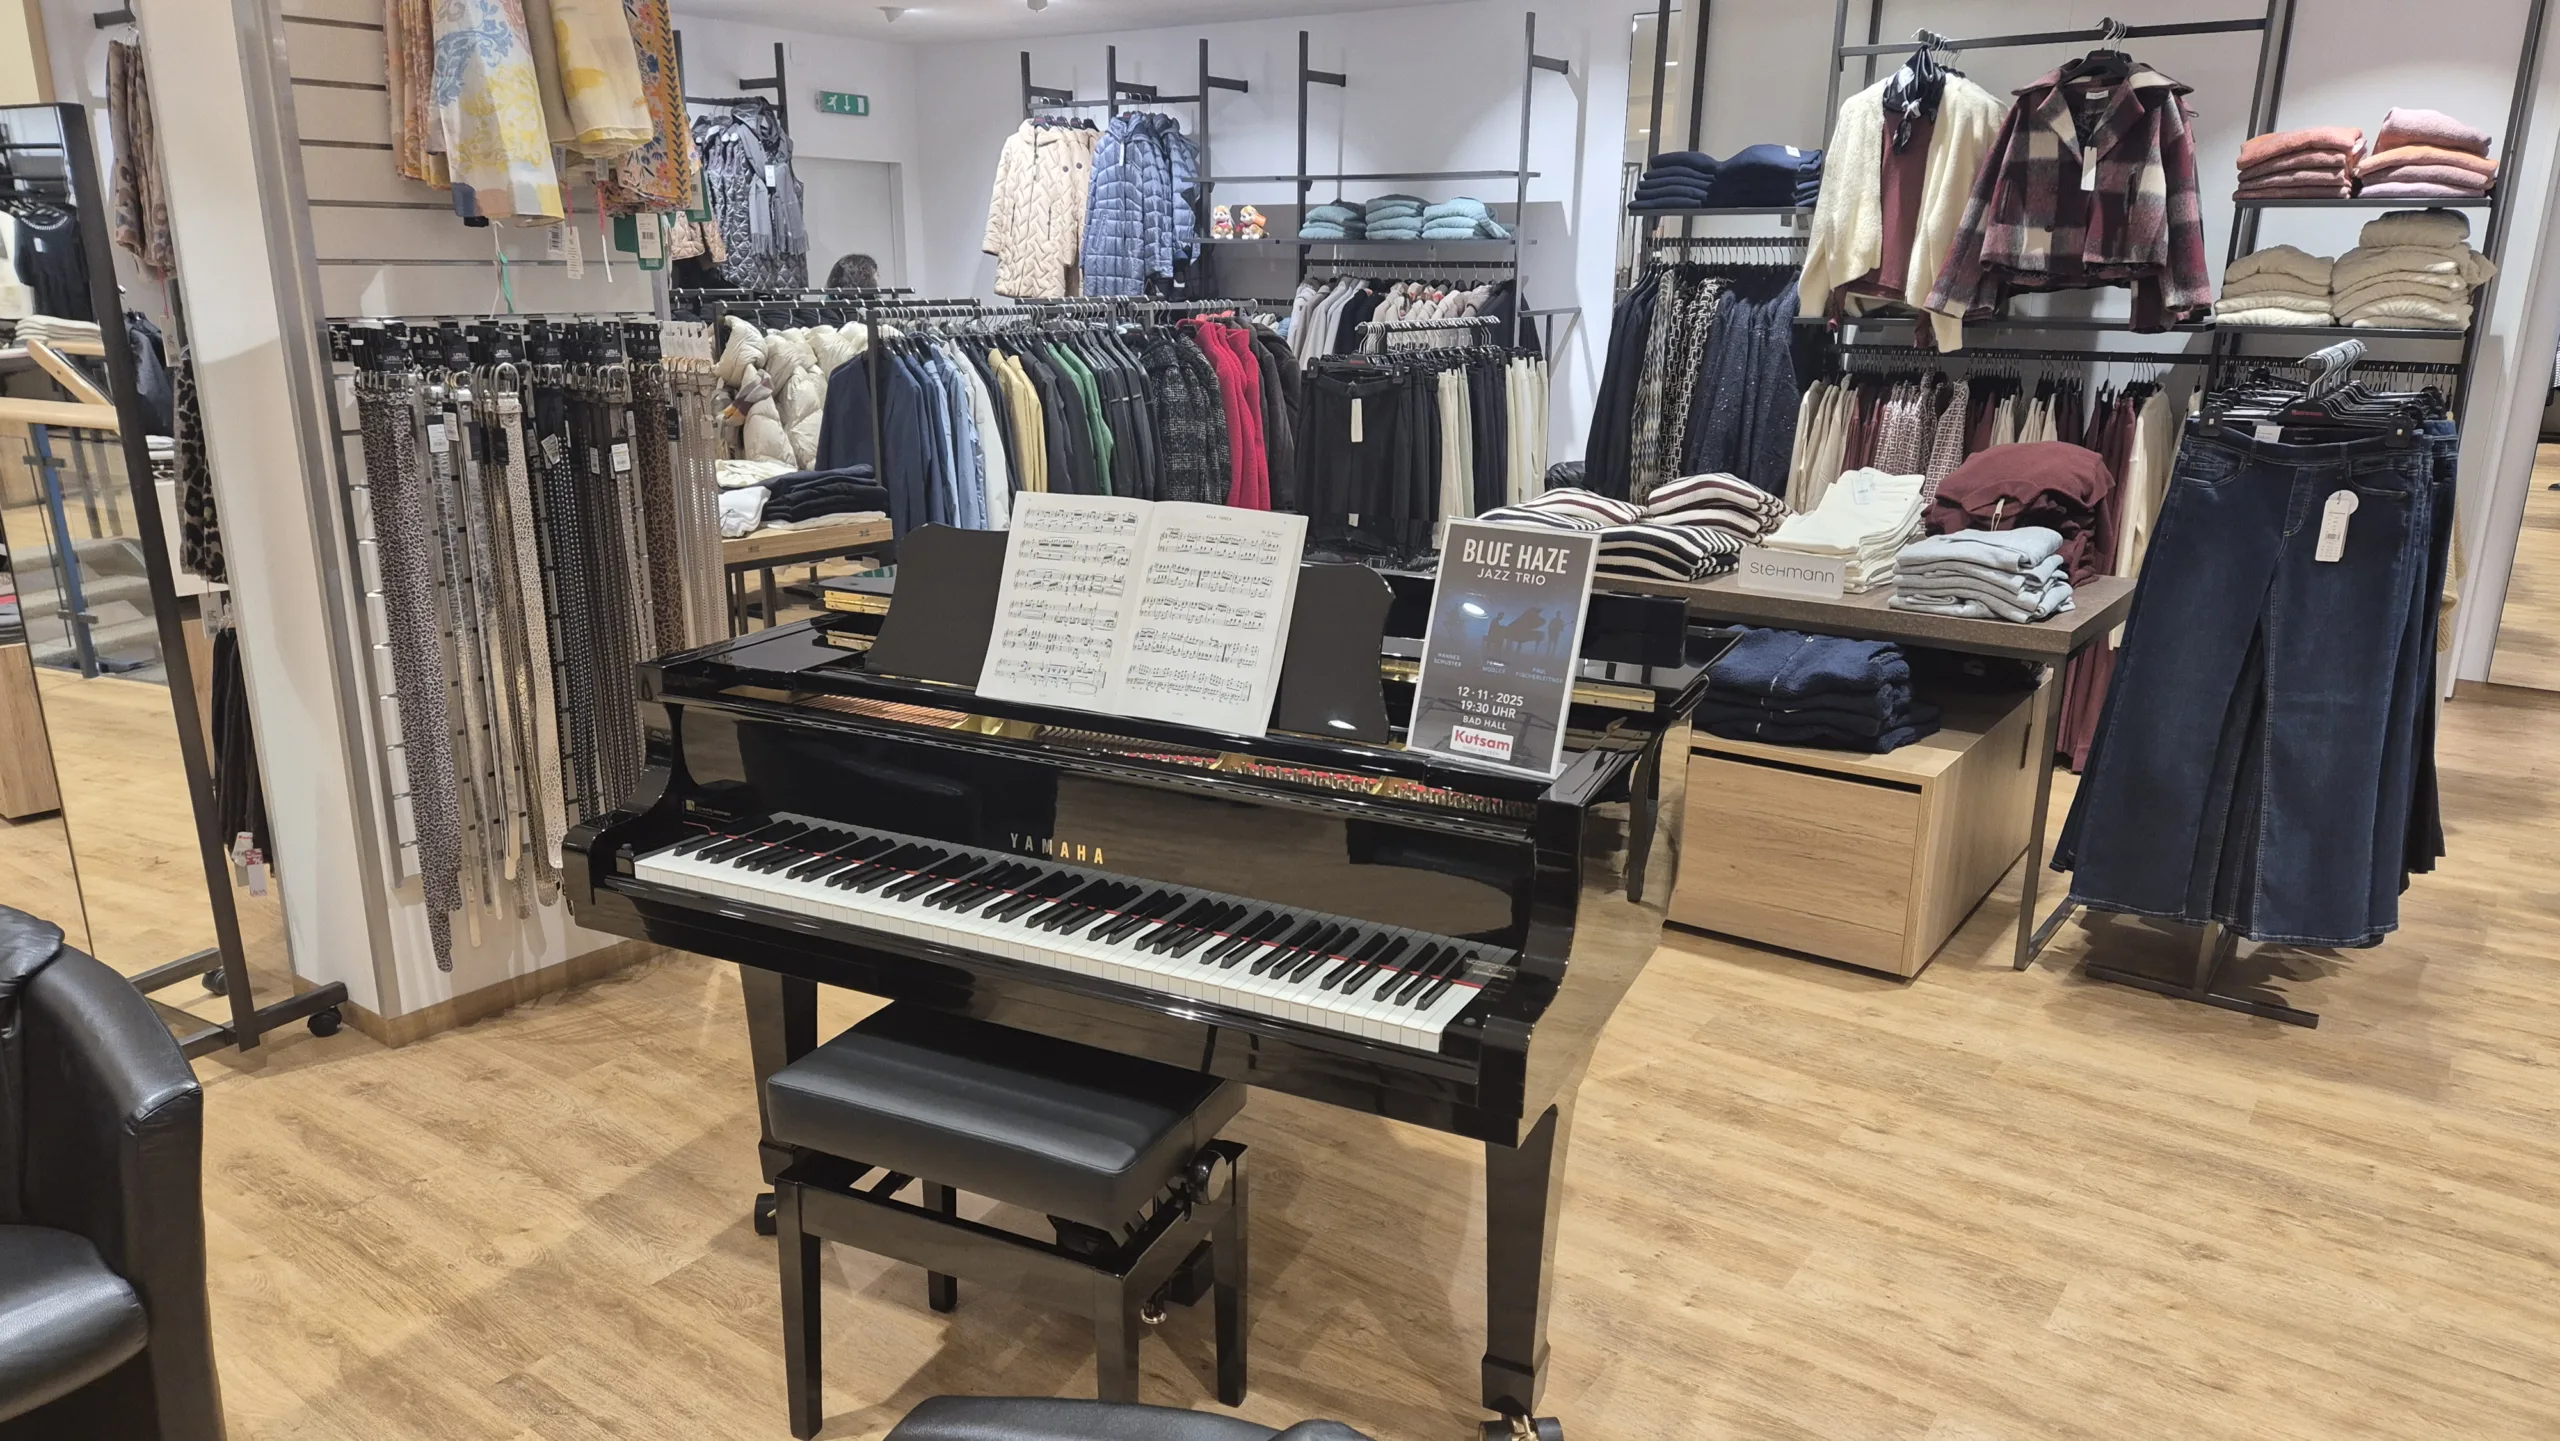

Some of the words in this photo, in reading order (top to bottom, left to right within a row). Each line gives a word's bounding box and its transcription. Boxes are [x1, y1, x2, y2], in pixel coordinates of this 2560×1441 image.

[1462, 538, 1513, 568] BLUE
[1516, 544, 1571, 575] HAZE
[1477, 568, 1511, 582] JAZZ
[1515, 572, 1546, 586] TRIO
[1433, 658, 1462, 667] SCHUSTER
[1437, 652, 1460, 661] HANNES
[1460, 700, 1489, 714] 19:30
[1492, 705, 1517, 719] UHR
[1462, 715, 1482, 726] BAD
[1483, 719, 1507, 731] HALL
[1454, 729, 1510, 752] Kutsam
[1010, 832, 1104, 865] YAMAHA
